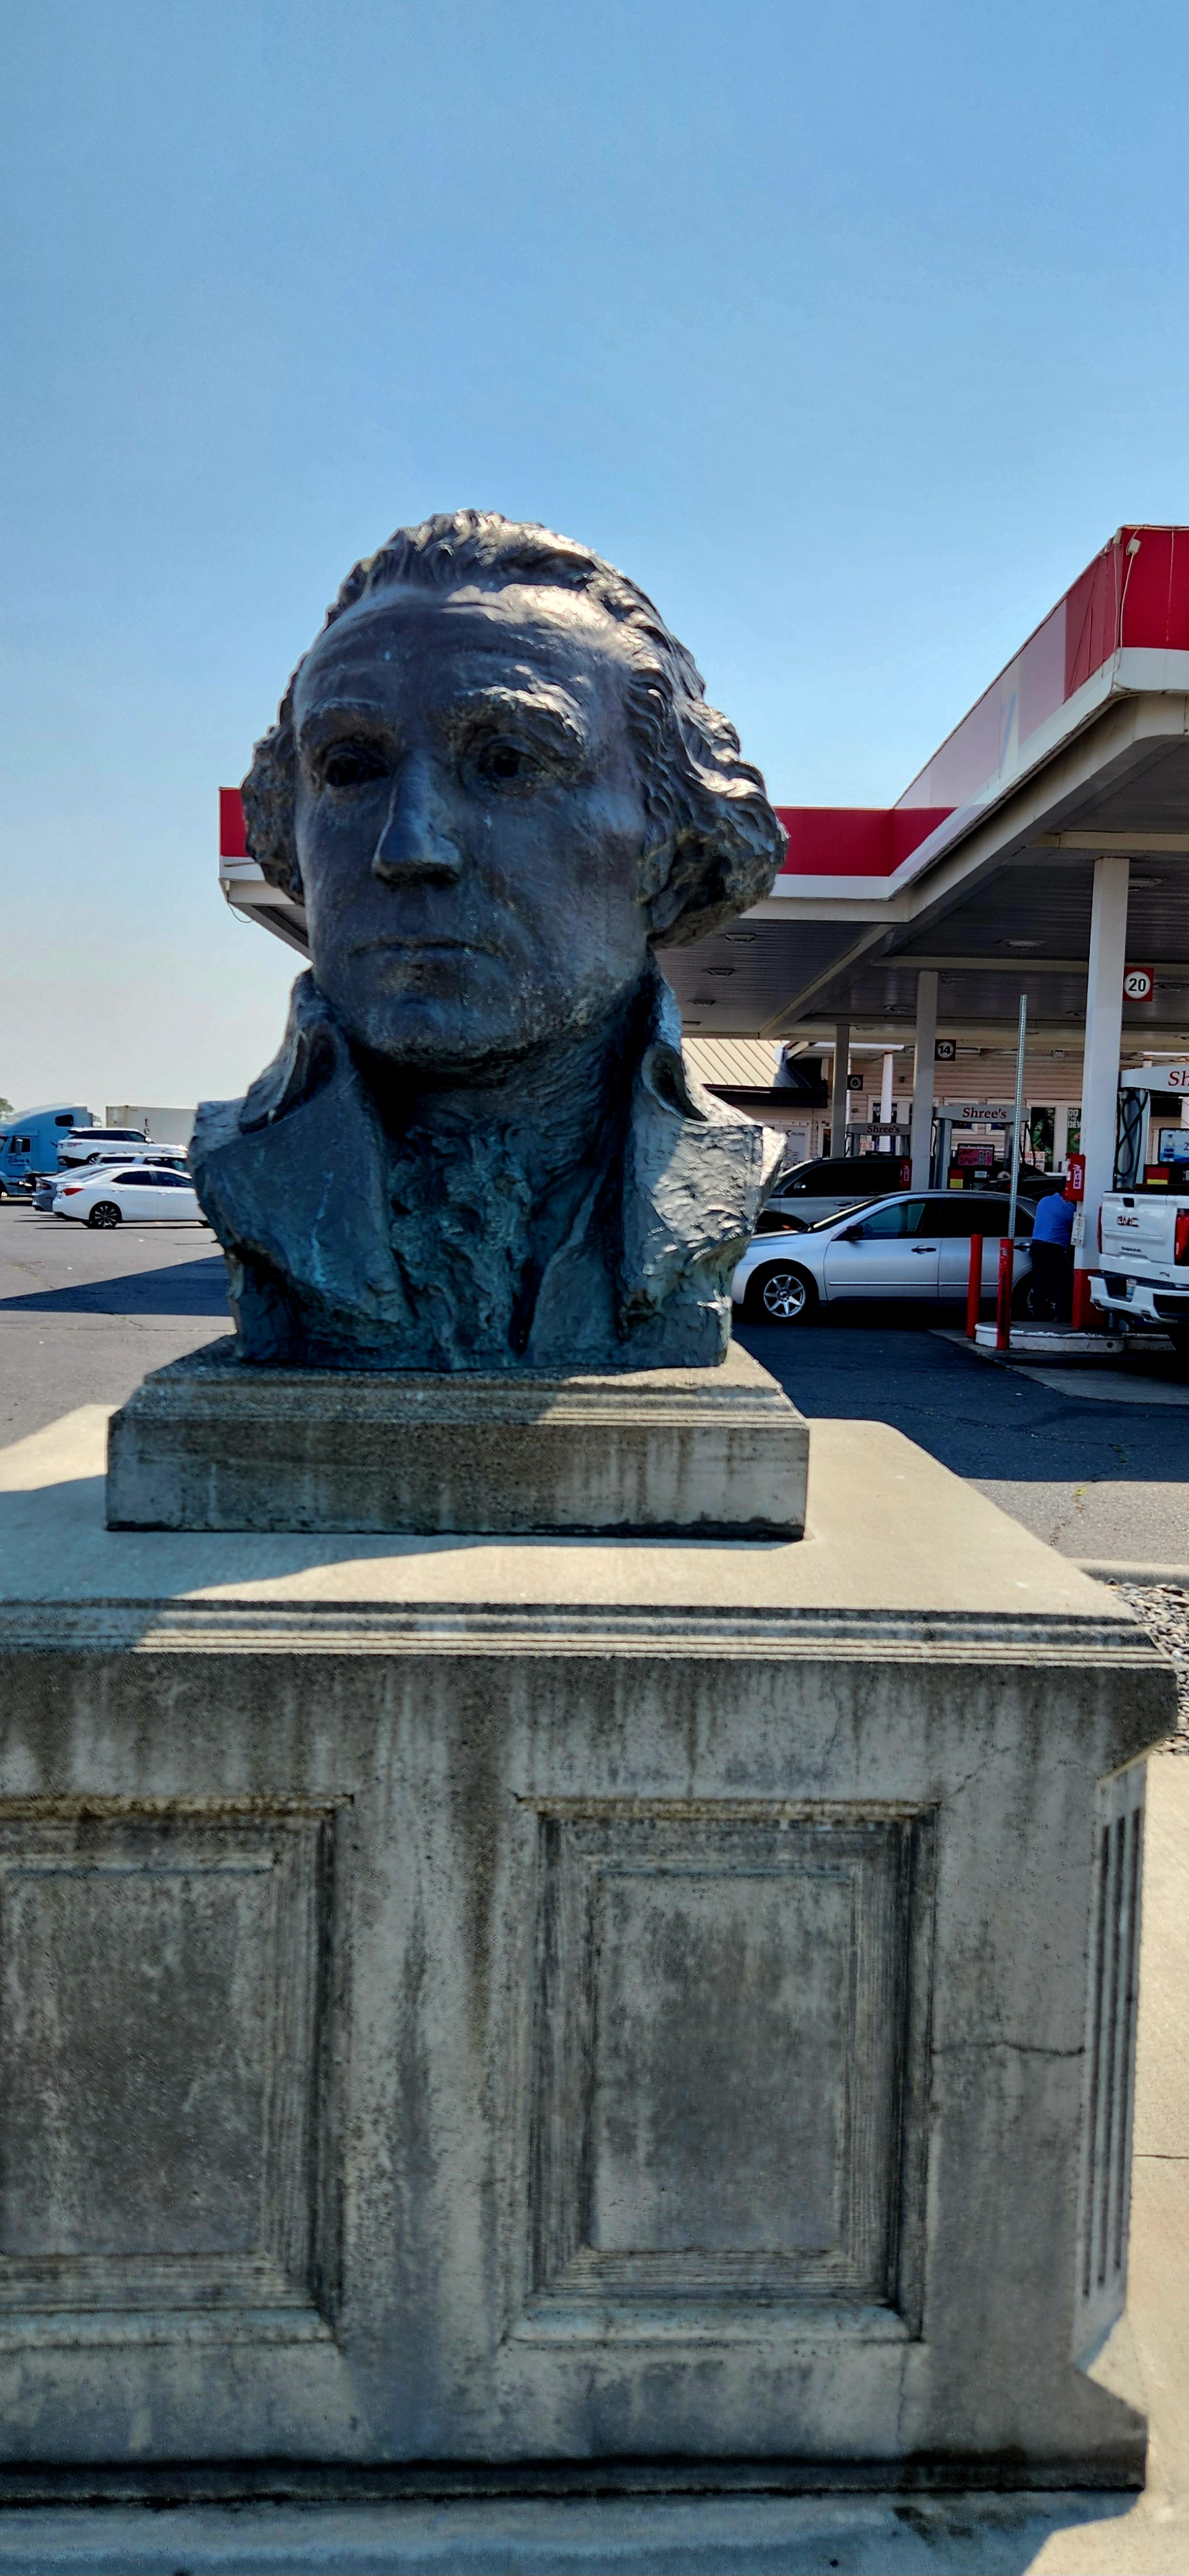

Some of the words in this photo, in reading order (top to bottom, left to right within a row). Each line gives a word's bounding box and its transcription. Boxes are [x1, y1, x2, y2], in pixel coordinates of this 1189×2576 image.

[1128, 978, 1147, 992] 20
[938, 1044, 951, 1055] 14
[1168, 1070, 1189, 1087] Sh
[962, 1108, 1007, 1118] Shree's
[867, 1125, 900, 1134] Shree's
[1116, 1215, 1139, 1228] GMC
